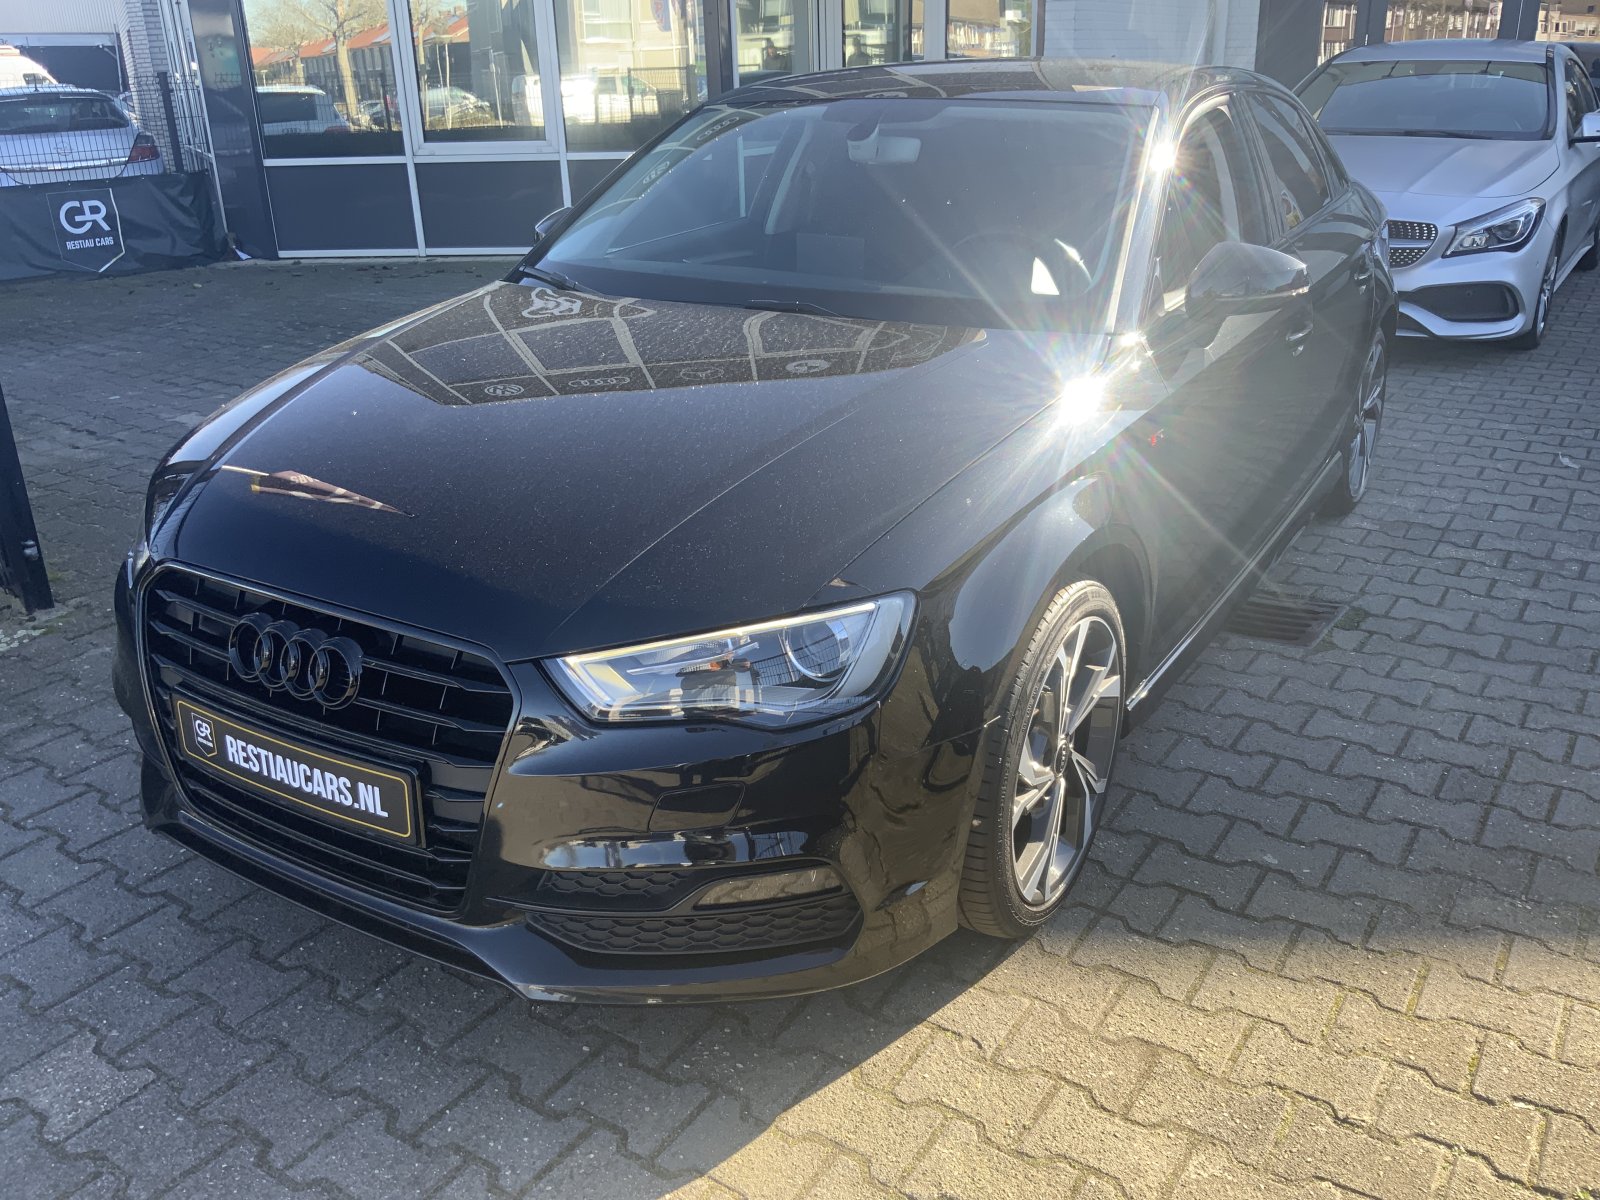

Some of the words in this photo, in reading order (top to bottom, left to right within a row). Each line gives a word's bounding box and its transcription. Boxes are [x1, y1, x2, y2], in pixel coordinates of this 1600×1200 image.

[66, 238, 95, 251] RESTIAU
[95, 236, 114, 247] CARS
[224, 734, 389, 818] RESTIAUCARS.NL
